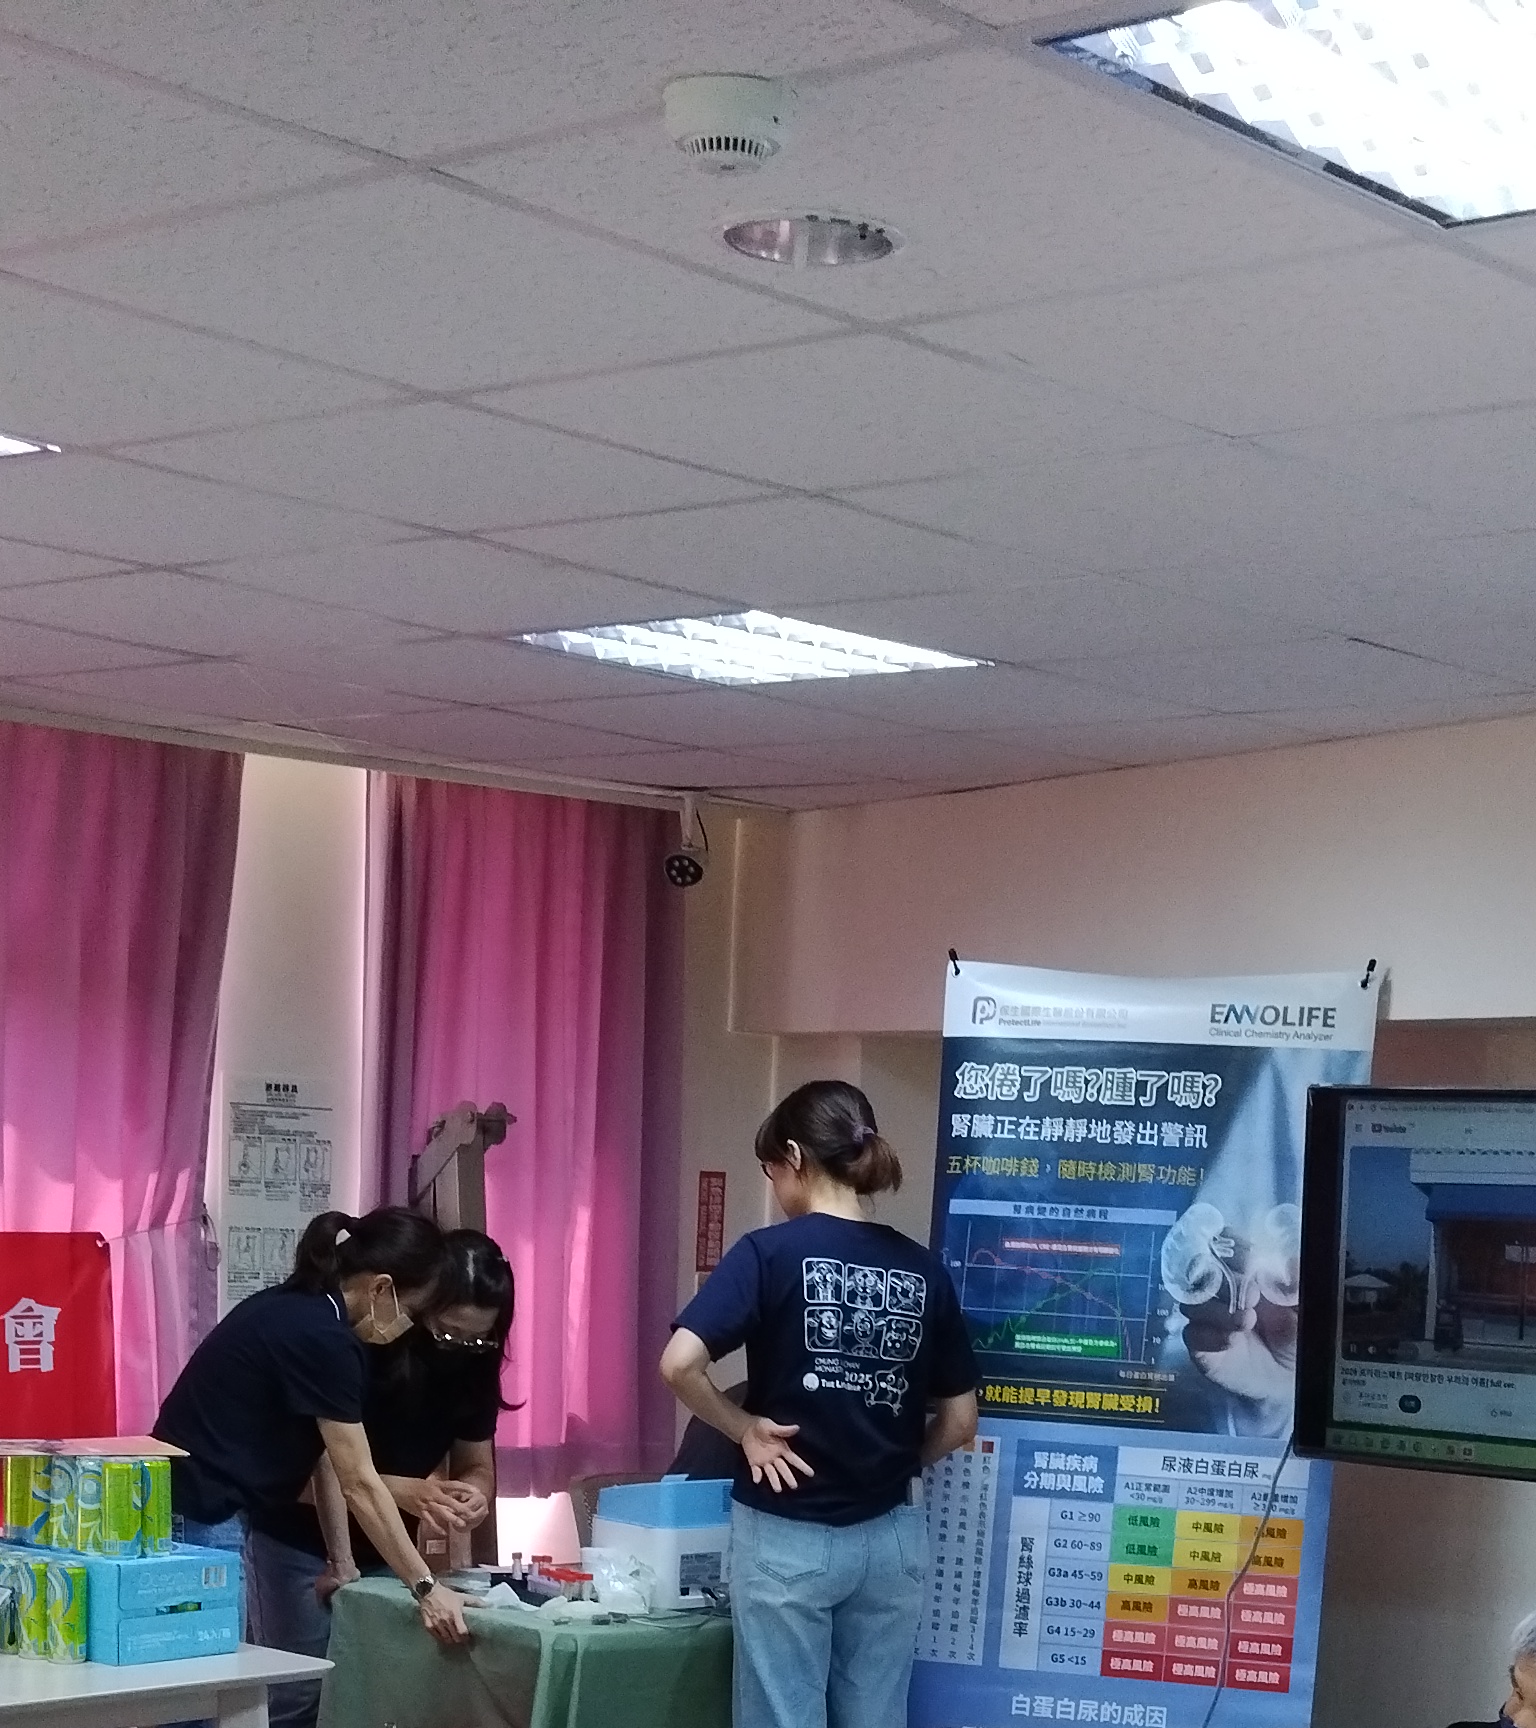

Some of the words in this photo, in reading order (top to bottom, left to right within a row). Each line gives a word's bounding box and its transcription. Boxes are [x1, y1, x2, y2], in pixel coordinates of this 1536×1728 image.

[1209, 1026, 1242, 1038] Clinical
[1245, 1028, 1290, 1041] Chemistry
[1292, 1030, 1334, 1042] Analyzer
[951, 1113, 1208, 1149] 腎臟正在靜靜地發出警訊
[1060, 1511, 1074, 1521] G1
[1127, 1514, 1161, 1529] 低風險
[1191, 1521, 1225, 1535] 中風險
[1054, 1539, 1069, 1549] G2
[1125, 1543, 1158, 1557] 低風險
[1189, 1550, 1223, 1564] 中風險
[1048, 1567, 1069, 1579] G3a
[1123, 1573, 1156, 1587] 中風險
[1187, 1577, 1220, 1591] 高風險
[1243, 1582, 1288, 1598] 極高風險
[1045, 1596, 1067, 1608] G3b
[1121, 1600, 1154, 1614] 高風險
[1177, 1603, 1222, 1621] 極高風險
[1240, 1609, 1286, 1626] 極高風險
[1047, 1625, 1062, 1636] G4
[1112, 1629, 1157, 1646] 極高風險
[1175, 1634, 1219, 1651] 極高風險
[1238, 1640, 1283, 1656] 極高風險
[1051, 1653, 1065, 1664] G5
[1110, 1657, 1155, 1673] 極高風險
[1172, 1662, 1216, 1679] 極高風險
[1235, 1667, 1280, 1685] 極高風險
[1011, 1693, 1167, 1728] 白蛋白尿的成因
